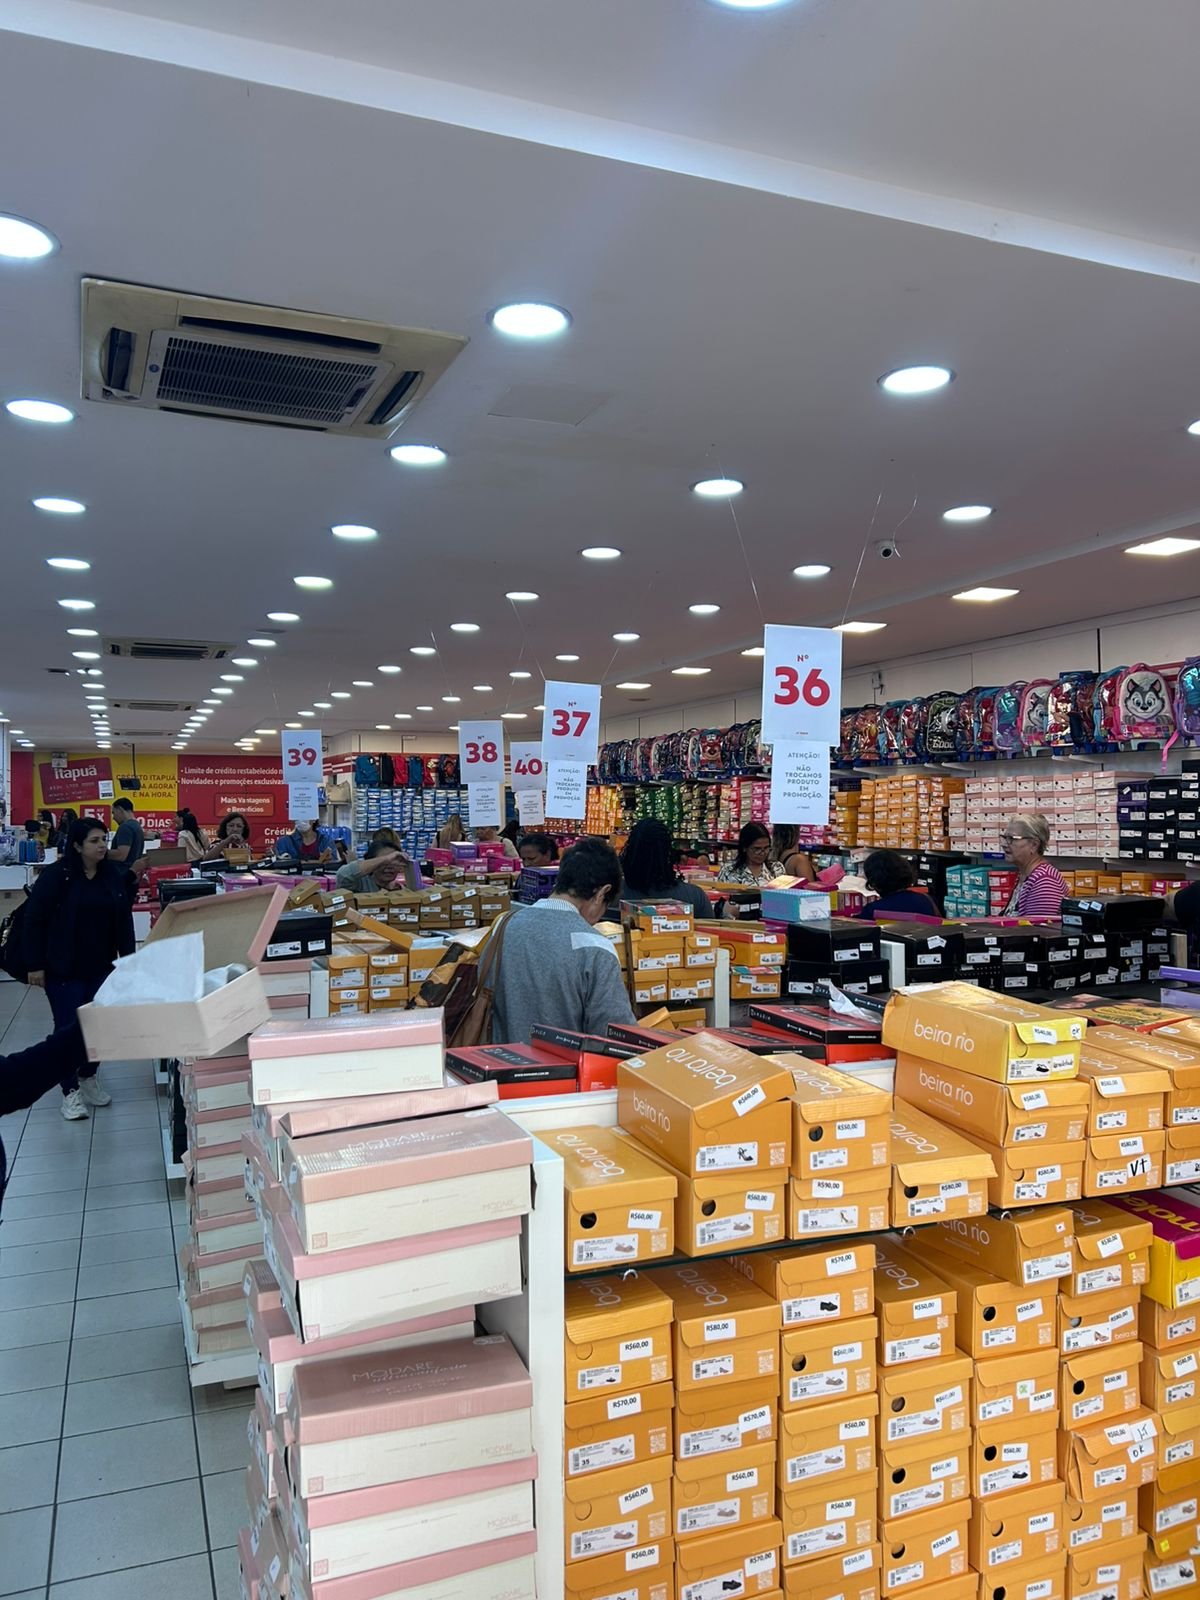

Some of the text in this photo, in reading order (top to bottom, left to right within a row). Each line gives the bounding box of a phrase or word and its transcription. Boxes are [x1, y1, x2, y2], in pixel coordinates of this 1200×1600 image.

[774, 666, 831, 707] 36
[551, 708, 591, 737] 37
[287, 748, 317, 767] 39
[465, 741, 498, 763] 38
[787, 751, 821, 760] ATENÇÃO!
[54, 765, 97, 781] itapuã
[514, 758, 543, 775] 40
[796, 764, 811, 772] NÃO
[220, 778, 253, 786] promoções
[783, 790, 823, 799] PROMOÇÃO.
[147, 818, 172, 828] DIAS
[914, 1018, 975, 1053] beira rio
[1095, 1030, 1196, 1061] beira rio
[665, 1047, 691, 1064] rio
[687, 1059, 737, 1090] beira
[792, 1069, 843, 1098] beira
[919, 1067, 974, 1106] beira rio
[633, 1091, 671, 1132] beira rio
[889, 1123, 938, 1155] beira
[556, 1133, 625, 1177] beira rio
[940, 1220, 991, 1245] eira rio
[676, 1268, 728, 1307] beira
